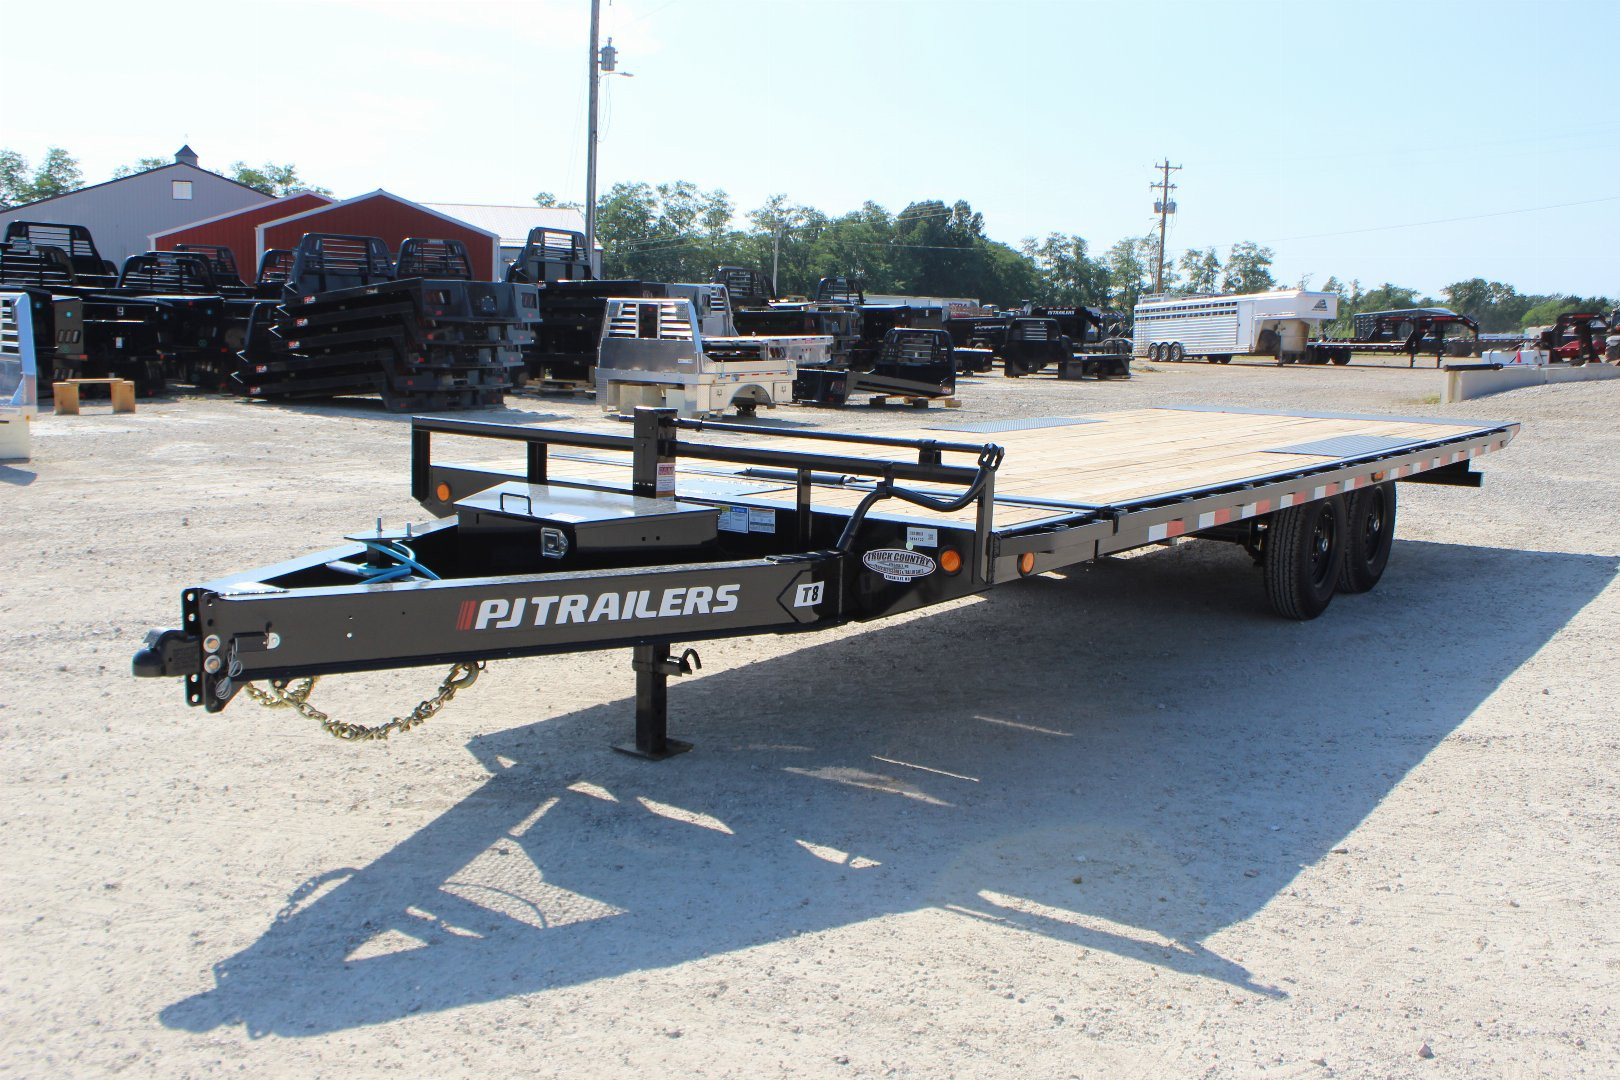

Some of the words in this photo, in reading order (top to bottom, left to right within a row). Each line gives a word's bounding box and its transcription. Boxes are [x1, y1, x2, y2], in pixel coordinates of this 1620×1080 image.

[867, 551, 893, 561] TRUCK
[893, 552, 930, 566] COUNTRY
[802, 585, 820, 603] T8
[530, 583, 741, 627] TRAILERS
